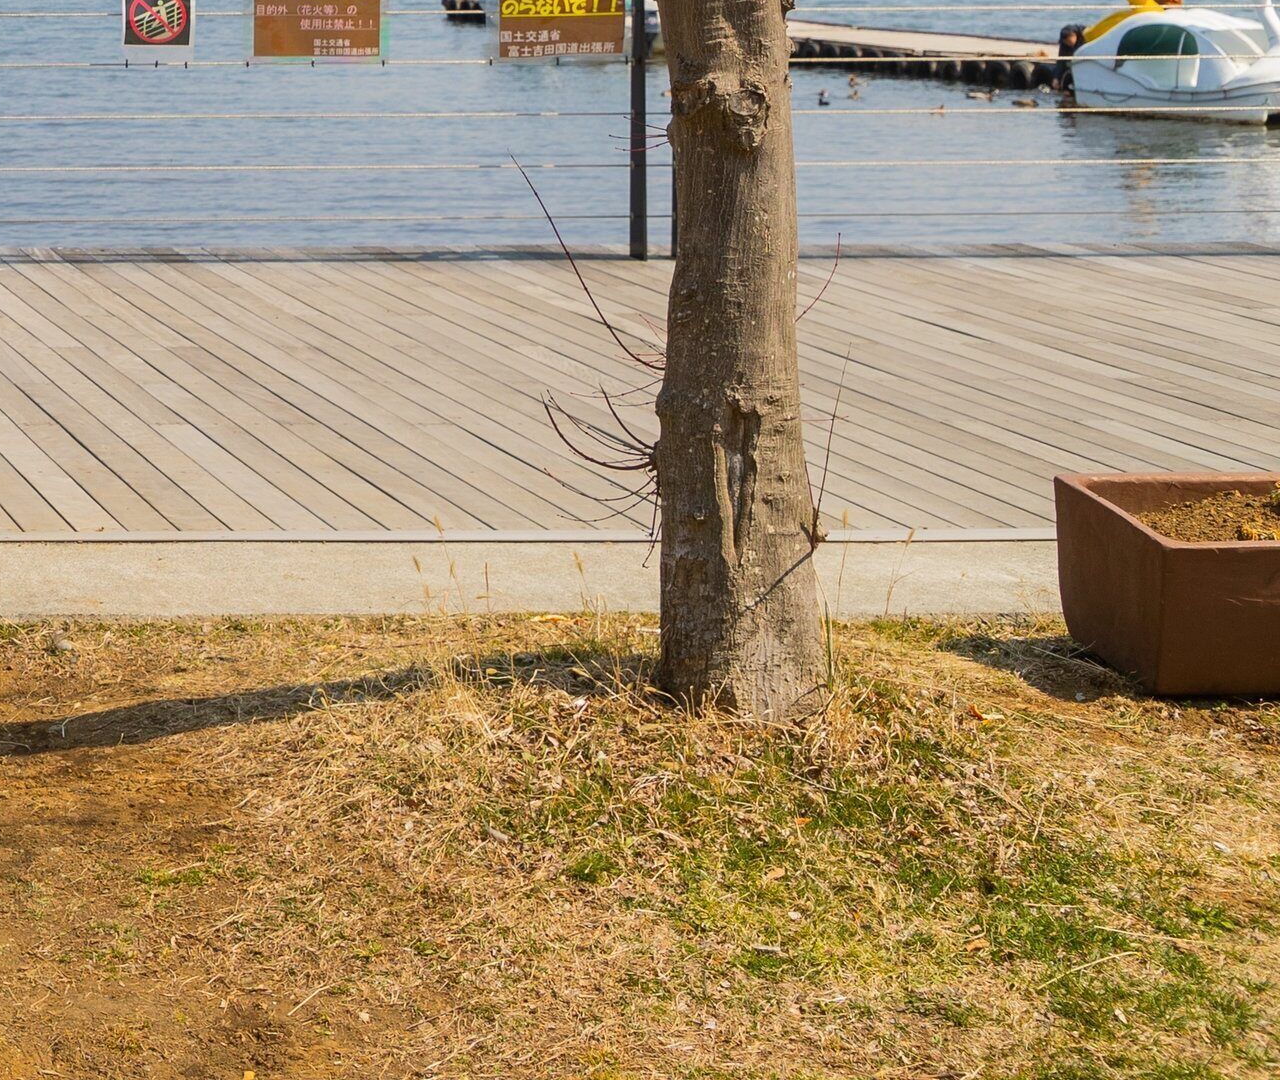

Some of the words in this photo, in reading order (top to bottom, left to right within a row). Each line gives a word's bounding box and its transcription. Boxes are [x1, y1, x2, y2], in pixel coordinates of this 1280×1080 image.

[500, 29, 561, 43] 国土交通省
[507, 41, 616, 58] 富士吉田国道出張所
